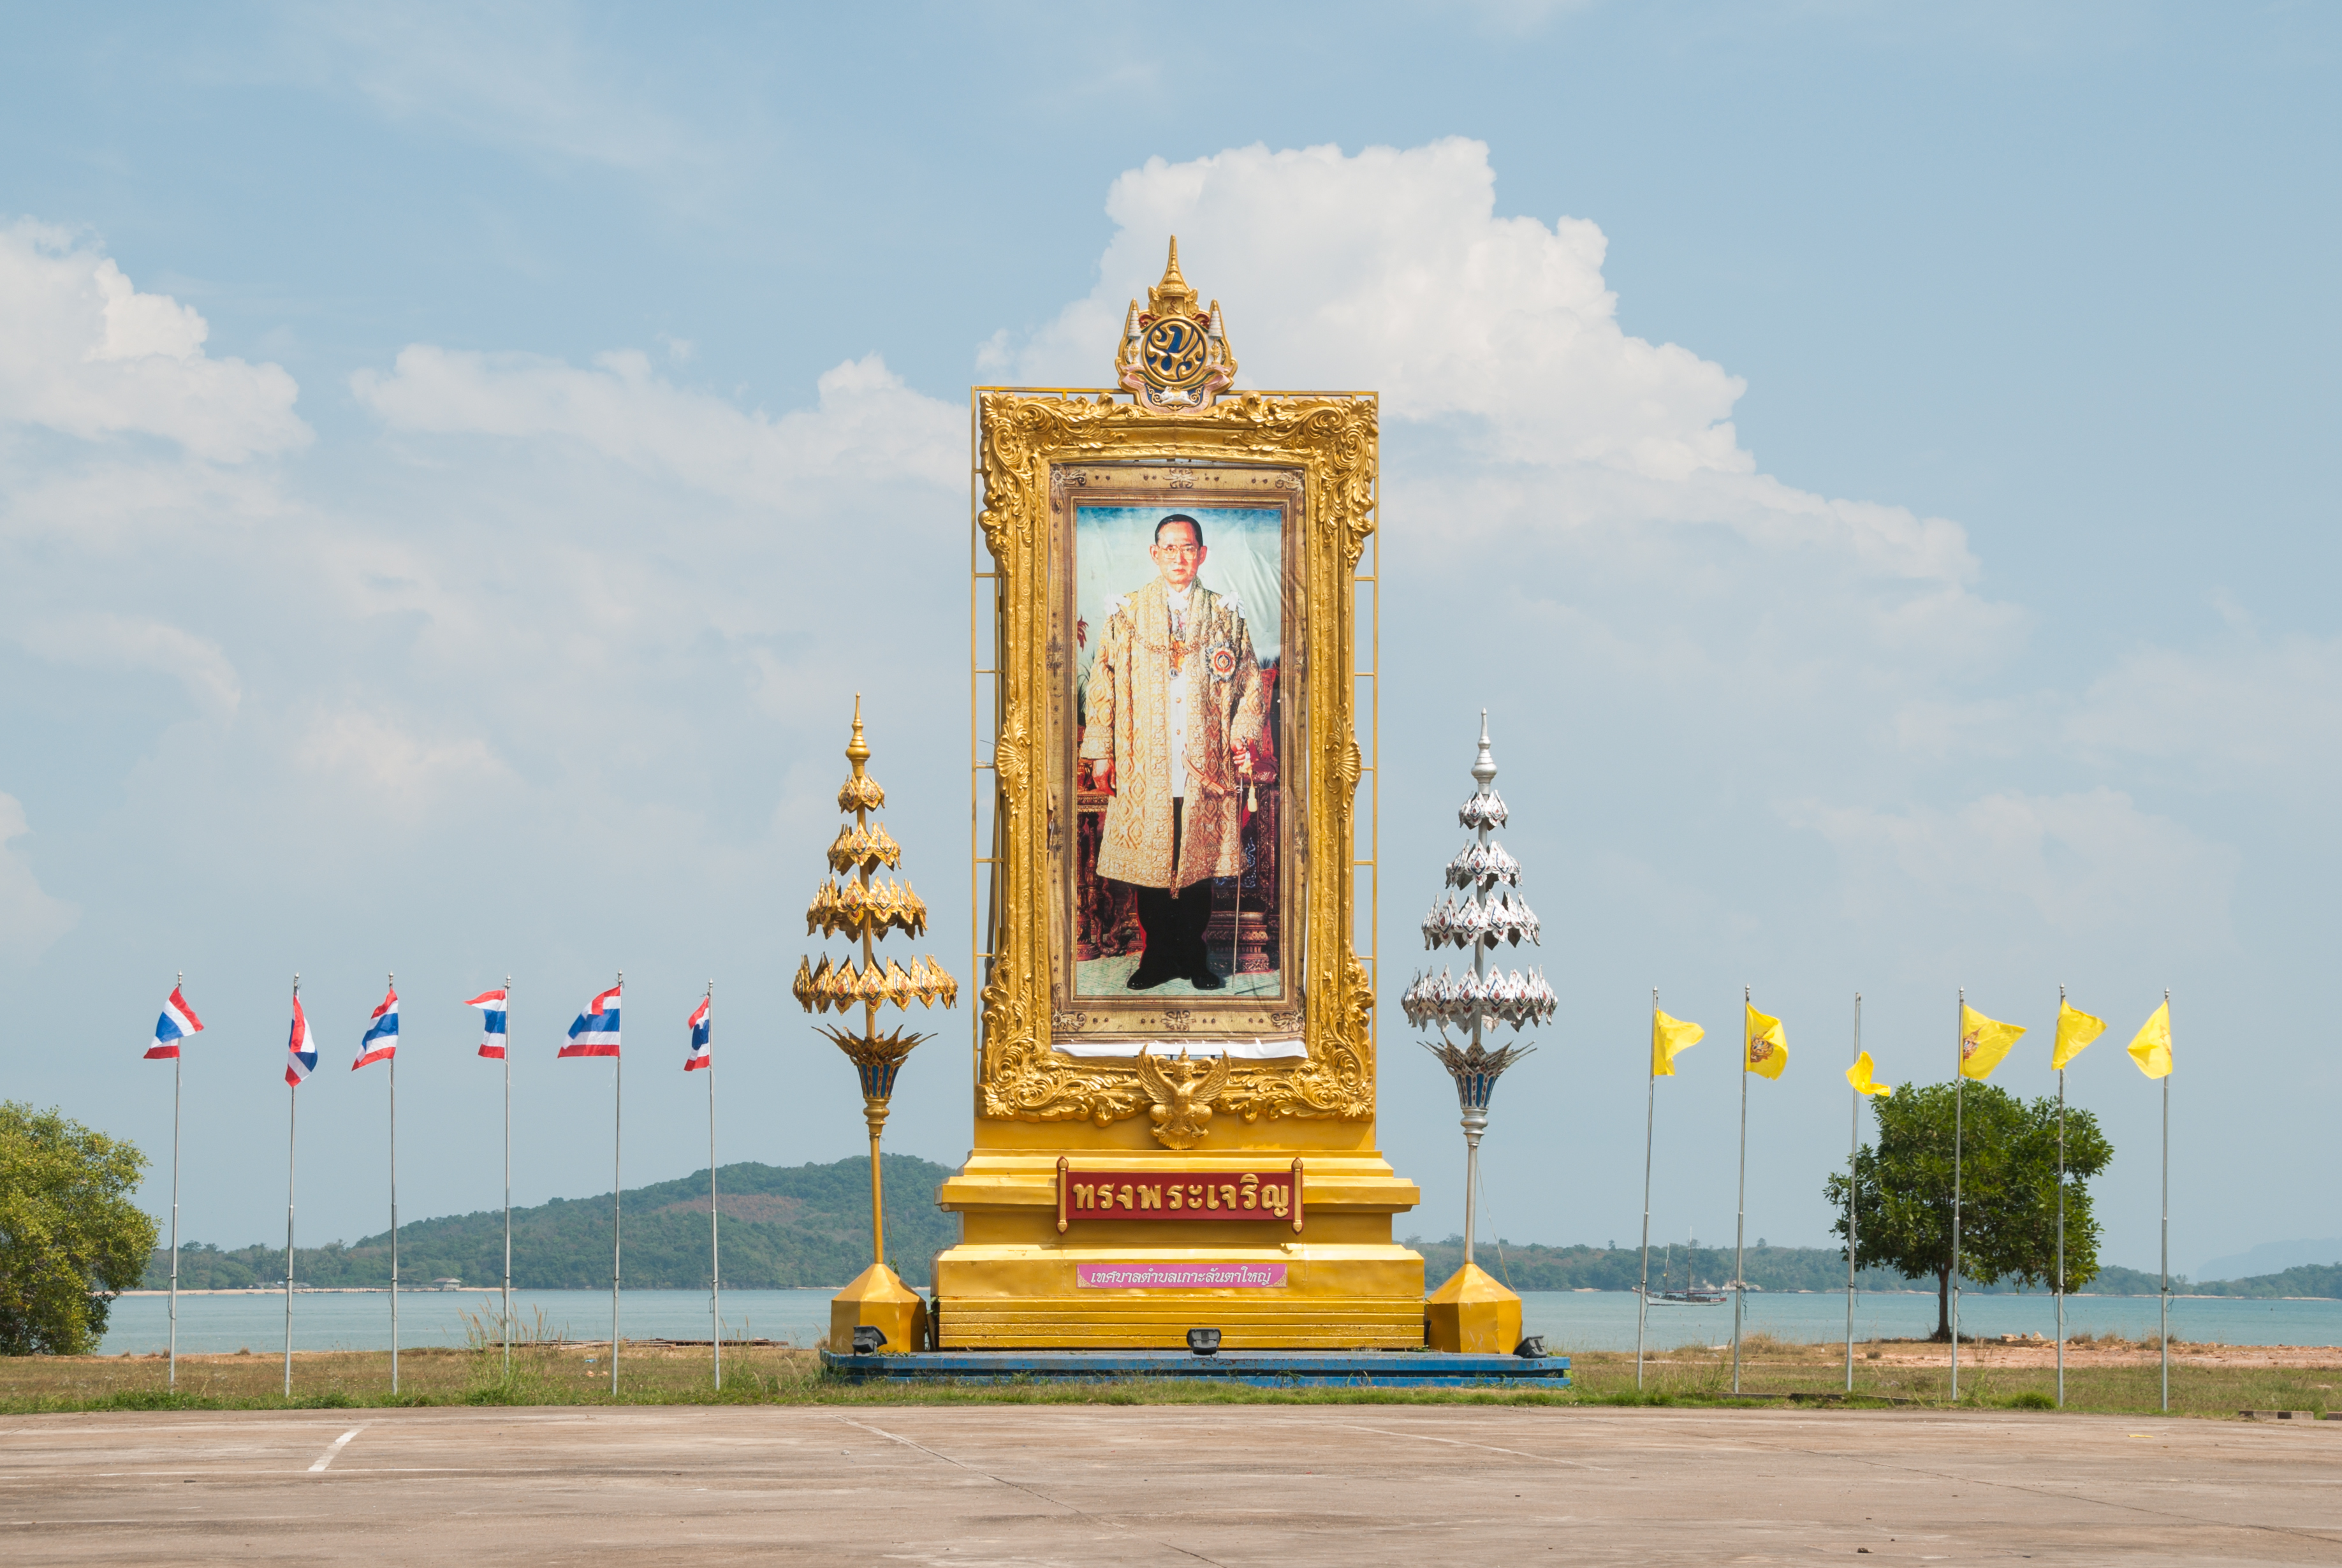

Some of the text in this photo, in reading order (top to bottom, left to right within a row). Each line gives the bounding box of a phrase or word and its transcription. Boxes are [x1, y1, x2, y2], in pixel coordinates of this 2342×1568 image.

[1072, 1173, 1289, 1217] ทรงพระเจริญ
[1090, 1266, 1272, 1286] เทศบาลตำบลเกาะลันตาใหญ่
